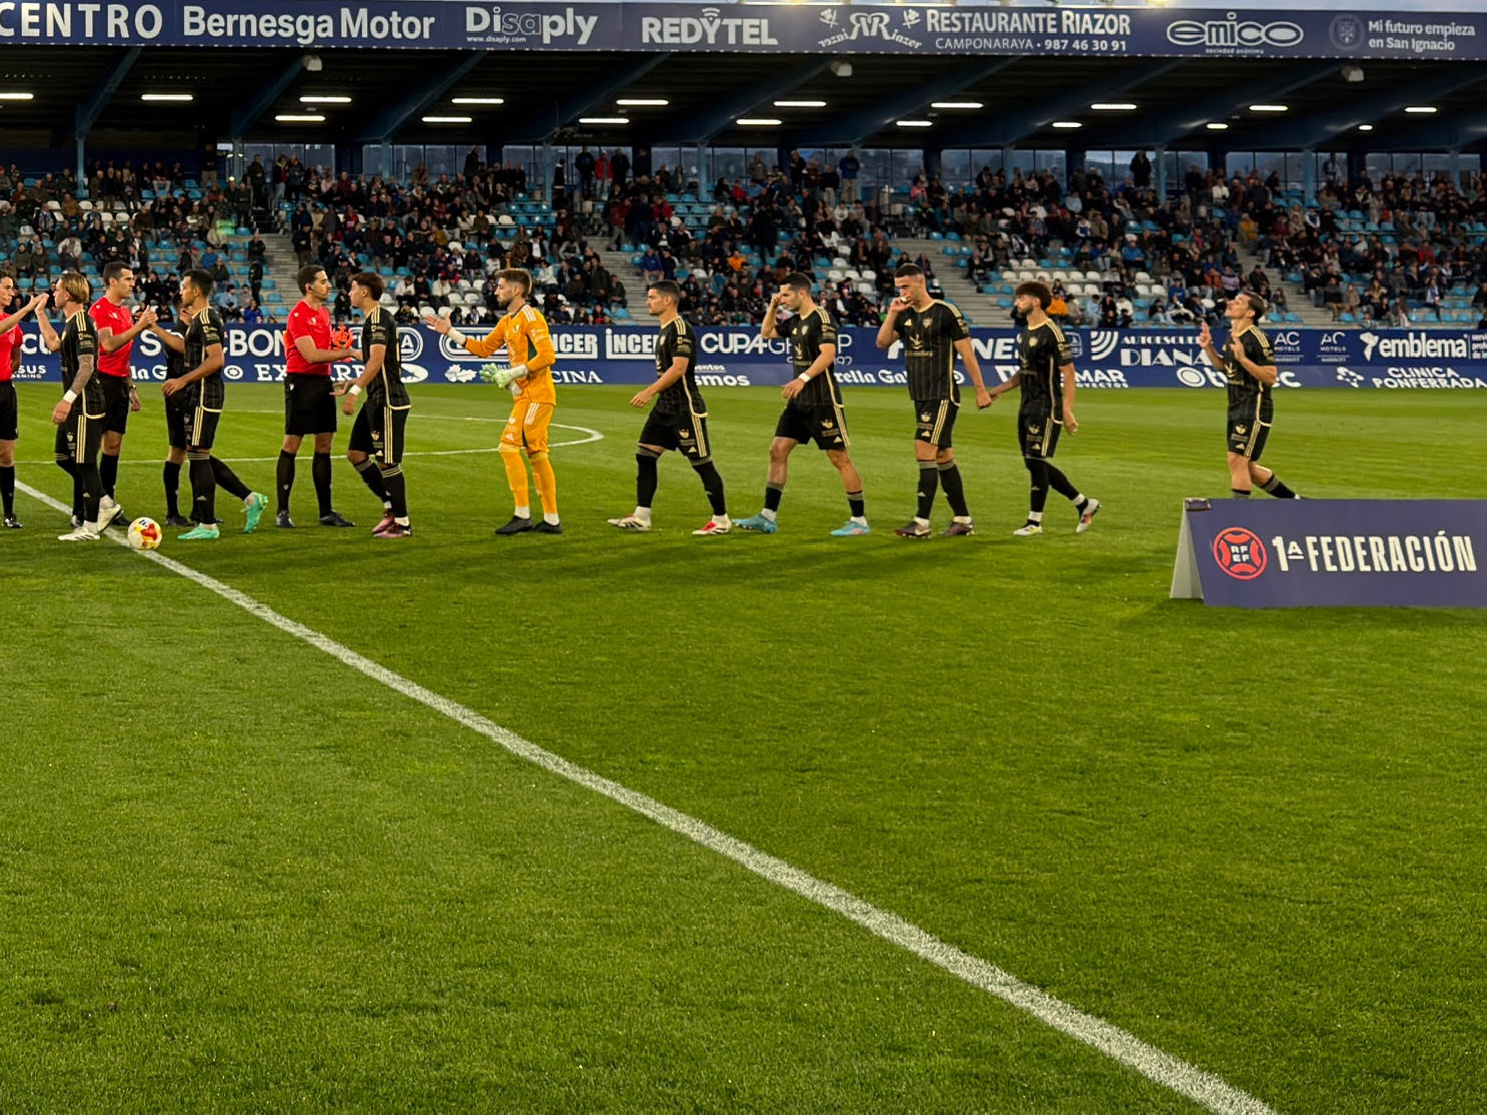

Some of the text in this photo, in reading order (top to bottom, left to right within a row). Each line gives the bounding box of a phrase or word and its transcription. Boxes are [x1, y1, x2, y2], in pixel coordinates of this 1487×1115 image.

[183, 5, 435, 44] Bernesga Motor
[465, 6, 598, 45] Disaply
[642, 16, 778, 46] REDYTEL
[926, 8, 1131, 36] RESTAURANTE RIAZOR
[1368, 19, 1476, 38] Mi futuro empieza
[466, 35, 526, 44] www.disaply.com
[935, 36, 1127, 52] CAMPONARAYA 987 46 30 91
[1368, 37, 1455, 53] en San Ignacio
[1274, 331, 1300, 345] AC
[1379, 332, 1467, 358] emblema
[1120, 348, 1213, 366] DIANA
[1387, 367, 1460, 378] CLINICA
[1372, 377, 1487, 388] PONFERRADA
[1305, 530, 1477, 572] FEDERACIÓN
